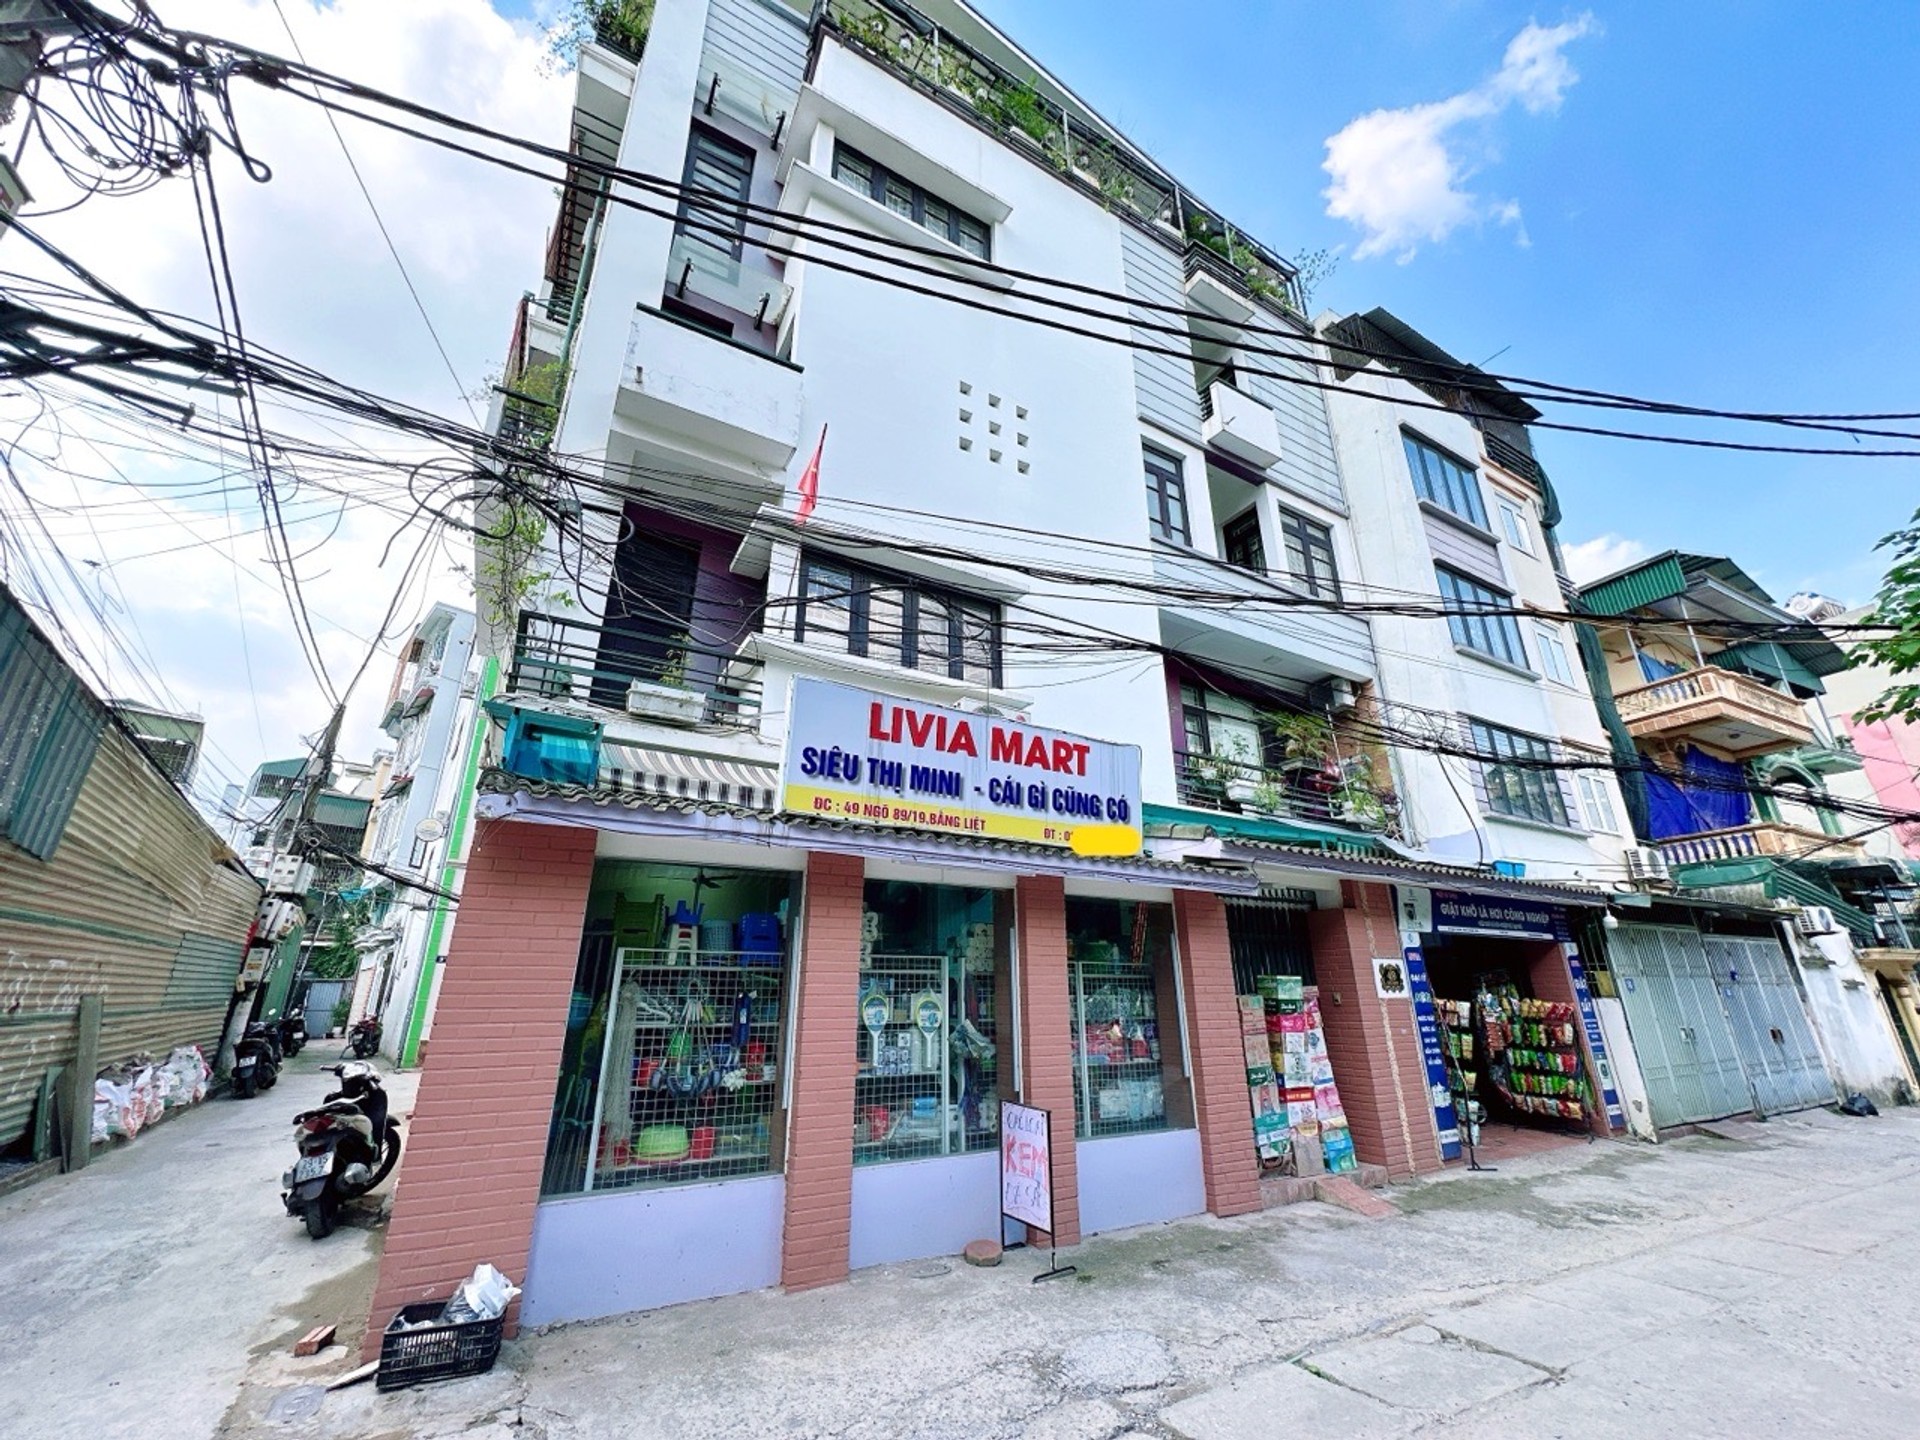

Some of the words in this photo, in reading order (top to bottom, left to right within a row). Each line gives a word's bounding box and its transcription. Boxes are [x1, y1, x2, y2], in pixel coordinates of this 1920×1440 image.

[869, 702, 978, 757] LIVIA
[990, 727, 1091, 777] MART
[801, 746, 860, 781] SIÊU
[867, 757, 903, 793] THỊ
[909, 764, 961, 797] MINI
[989, 775, 1021, 806] CÁI
[1028, 780, 1046, 810] GÌ
[1052, 785, 1100, 818] CŨNG
[1106, 794, 1128, 822] CÓ
[844, 800, 859, 815] 49
[1440, 902, 1460, 919] GIẶT
